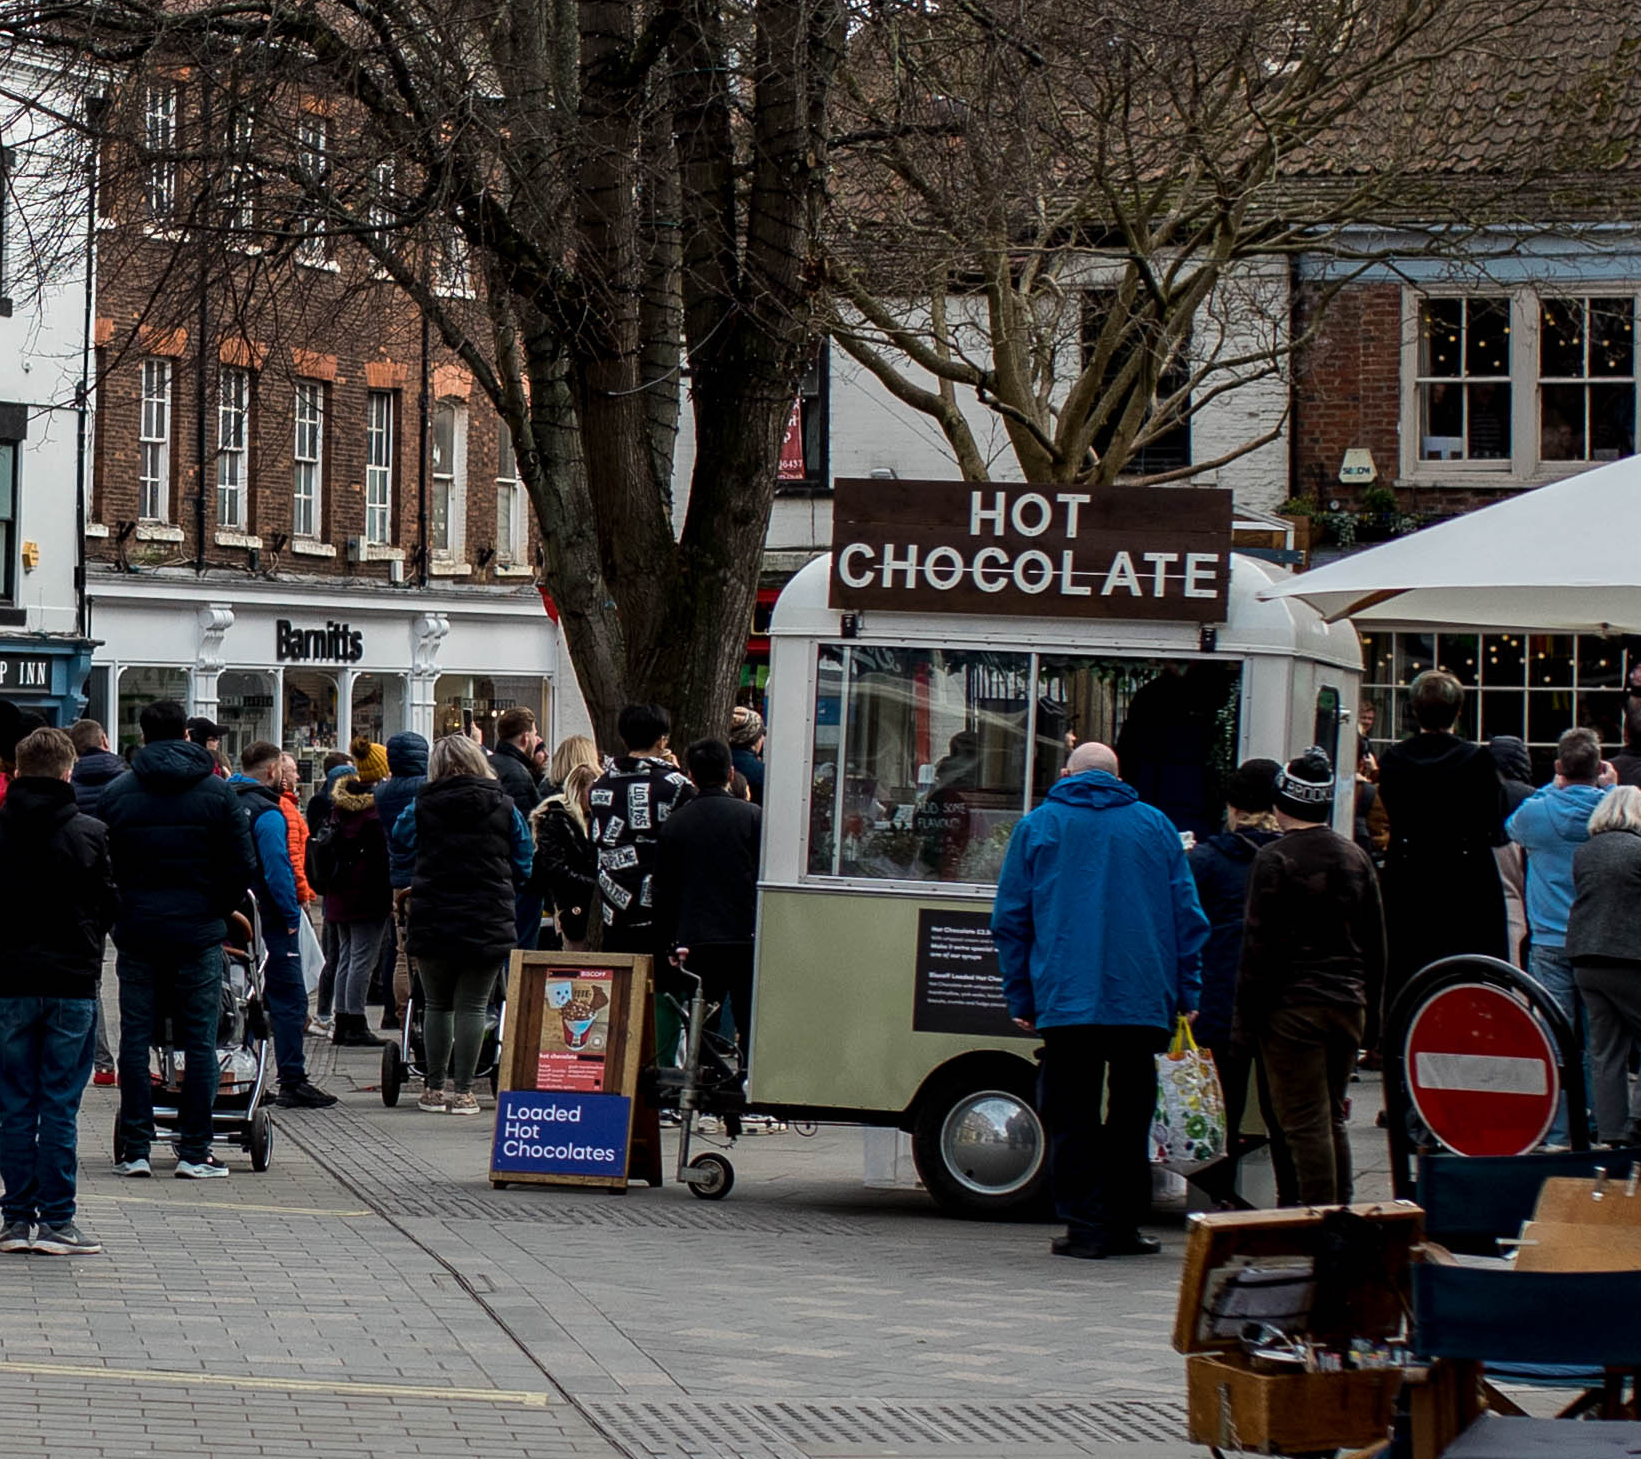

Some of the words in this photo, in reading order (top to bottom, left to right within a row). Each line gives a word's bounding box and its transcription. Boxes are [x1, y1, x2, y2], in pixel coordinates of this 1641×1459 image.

[970, 491, 1091, 539] HOT
[839, 542, 1219, 599] CHOCOLATE
[276, 619, 364, 663] Barnitts
[19, 662, 47, 685] INN
[506, 1103, 581, 1122] Loaded
[505, 1122, 540, 1139] Hot
[503, 1140, 615, 1161] Chocolates
